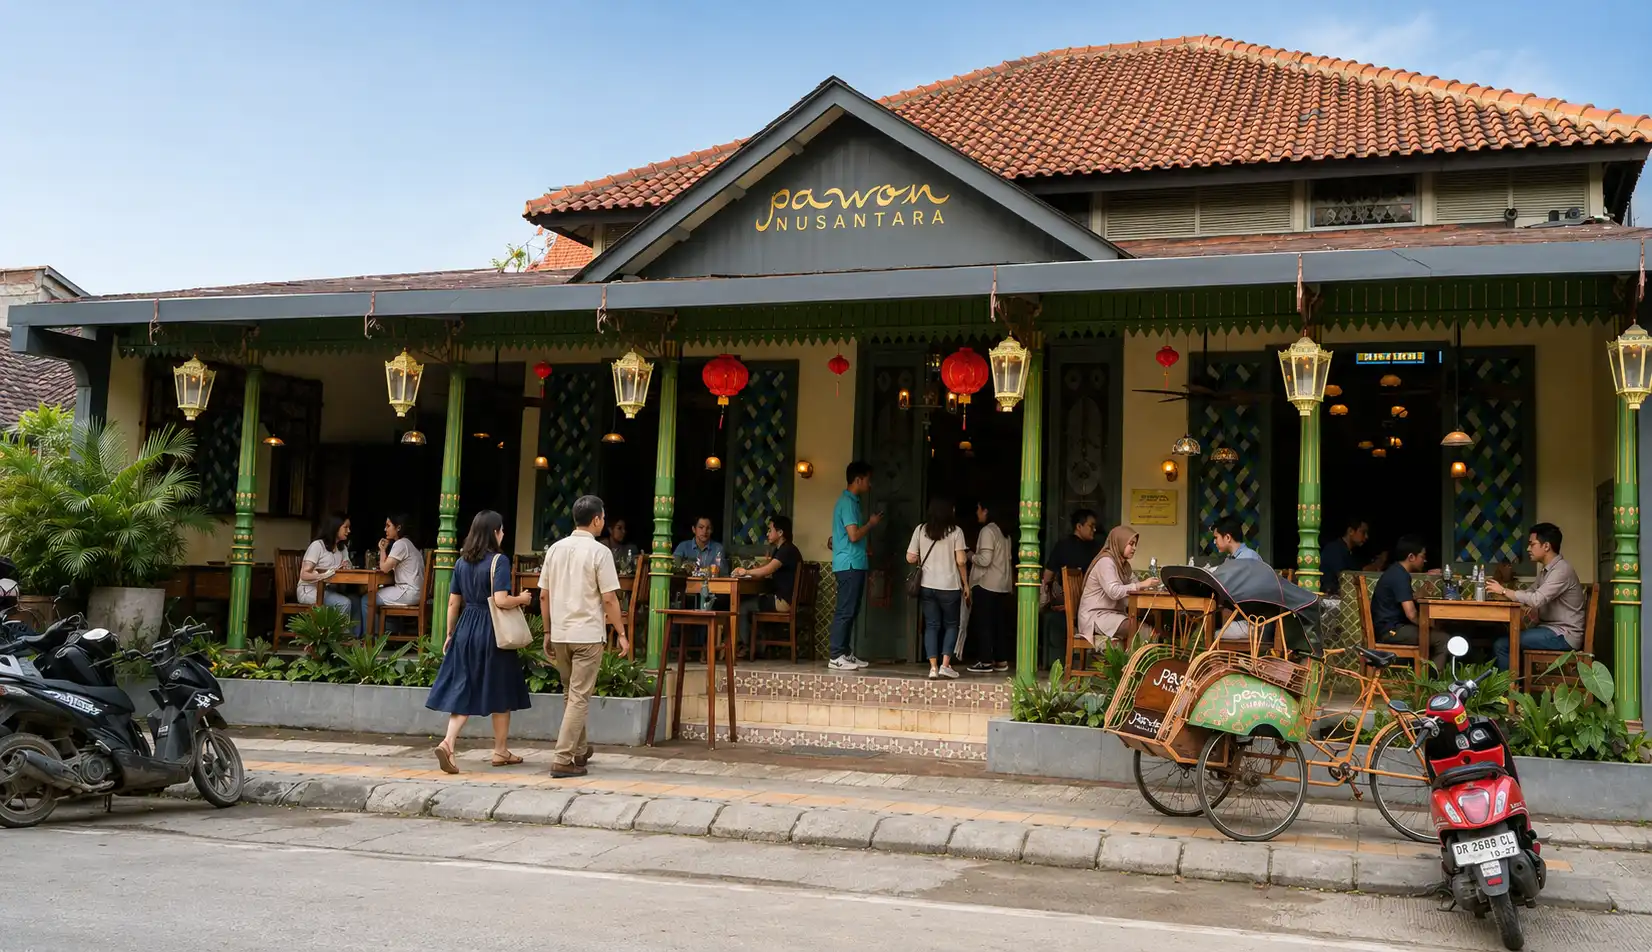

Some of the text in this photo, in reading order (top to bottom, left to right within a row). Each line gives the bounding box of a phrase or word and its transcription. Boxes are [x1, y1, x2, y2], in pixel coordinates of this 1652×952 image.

[755, 183, 950, 232] pawon
[776, 209, 945, 231] NUSANTARA
[1455, 844, 1469, 855] DR
[1500, 834, 1514, 846] CL
